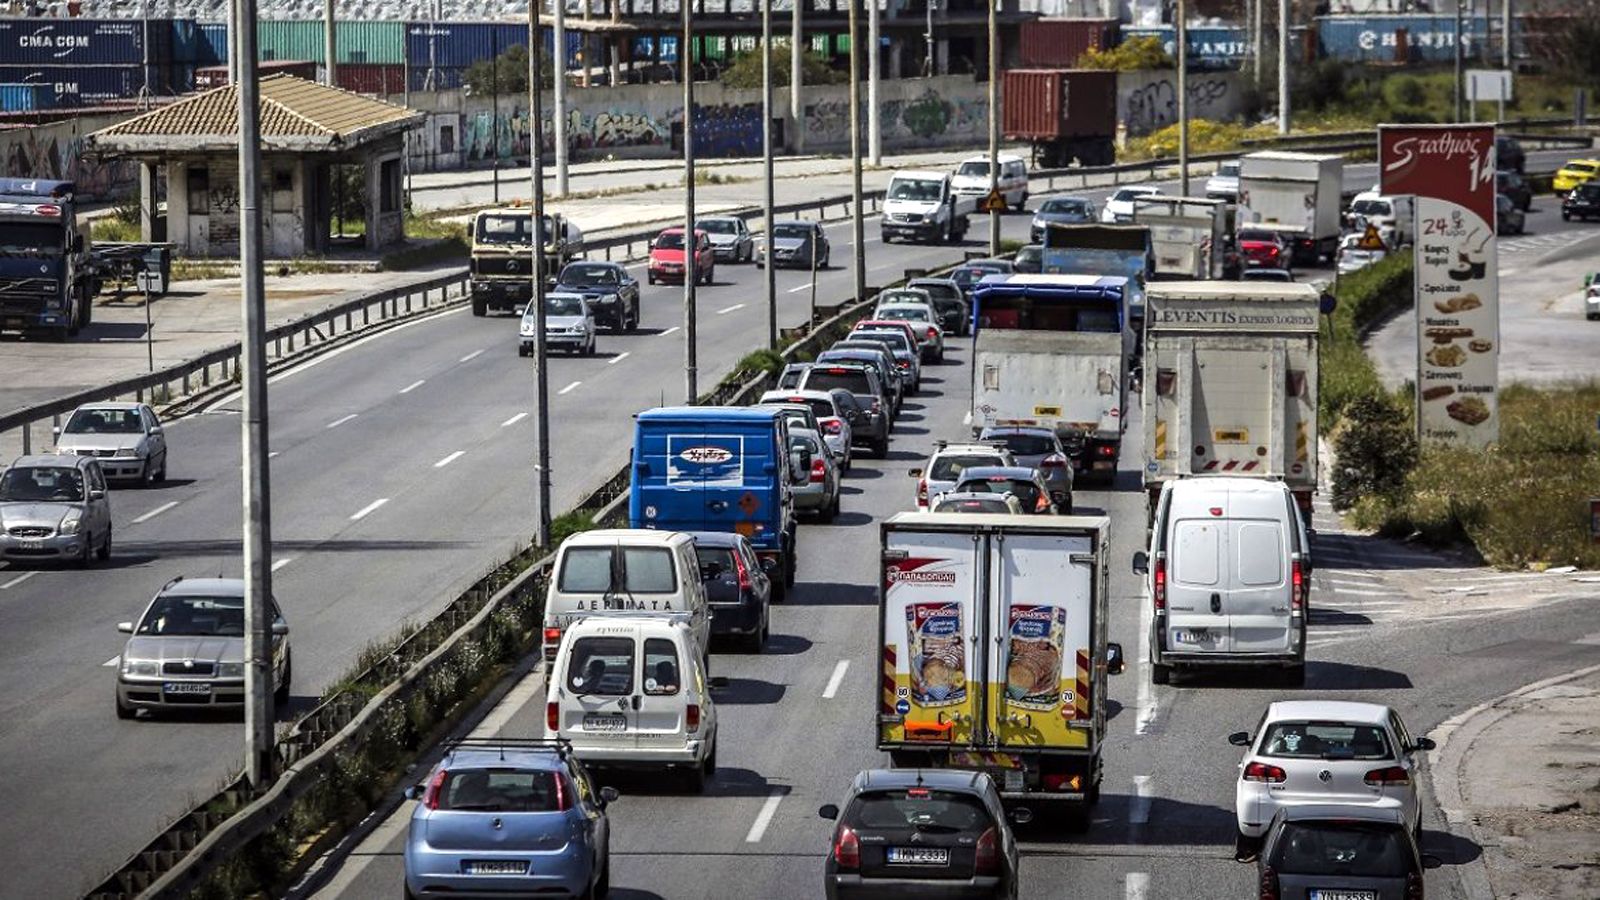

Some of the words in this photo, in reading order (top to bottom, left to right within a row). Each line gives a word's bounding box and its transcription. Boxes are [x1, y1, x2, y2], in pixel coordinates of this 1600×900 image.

[19, 35, 53, 48] CMA
[56, 35, 89, 48] CGM
[55, 82, 79, 94] GM
[1153, 310, 1236, 323] LEVENTIS
